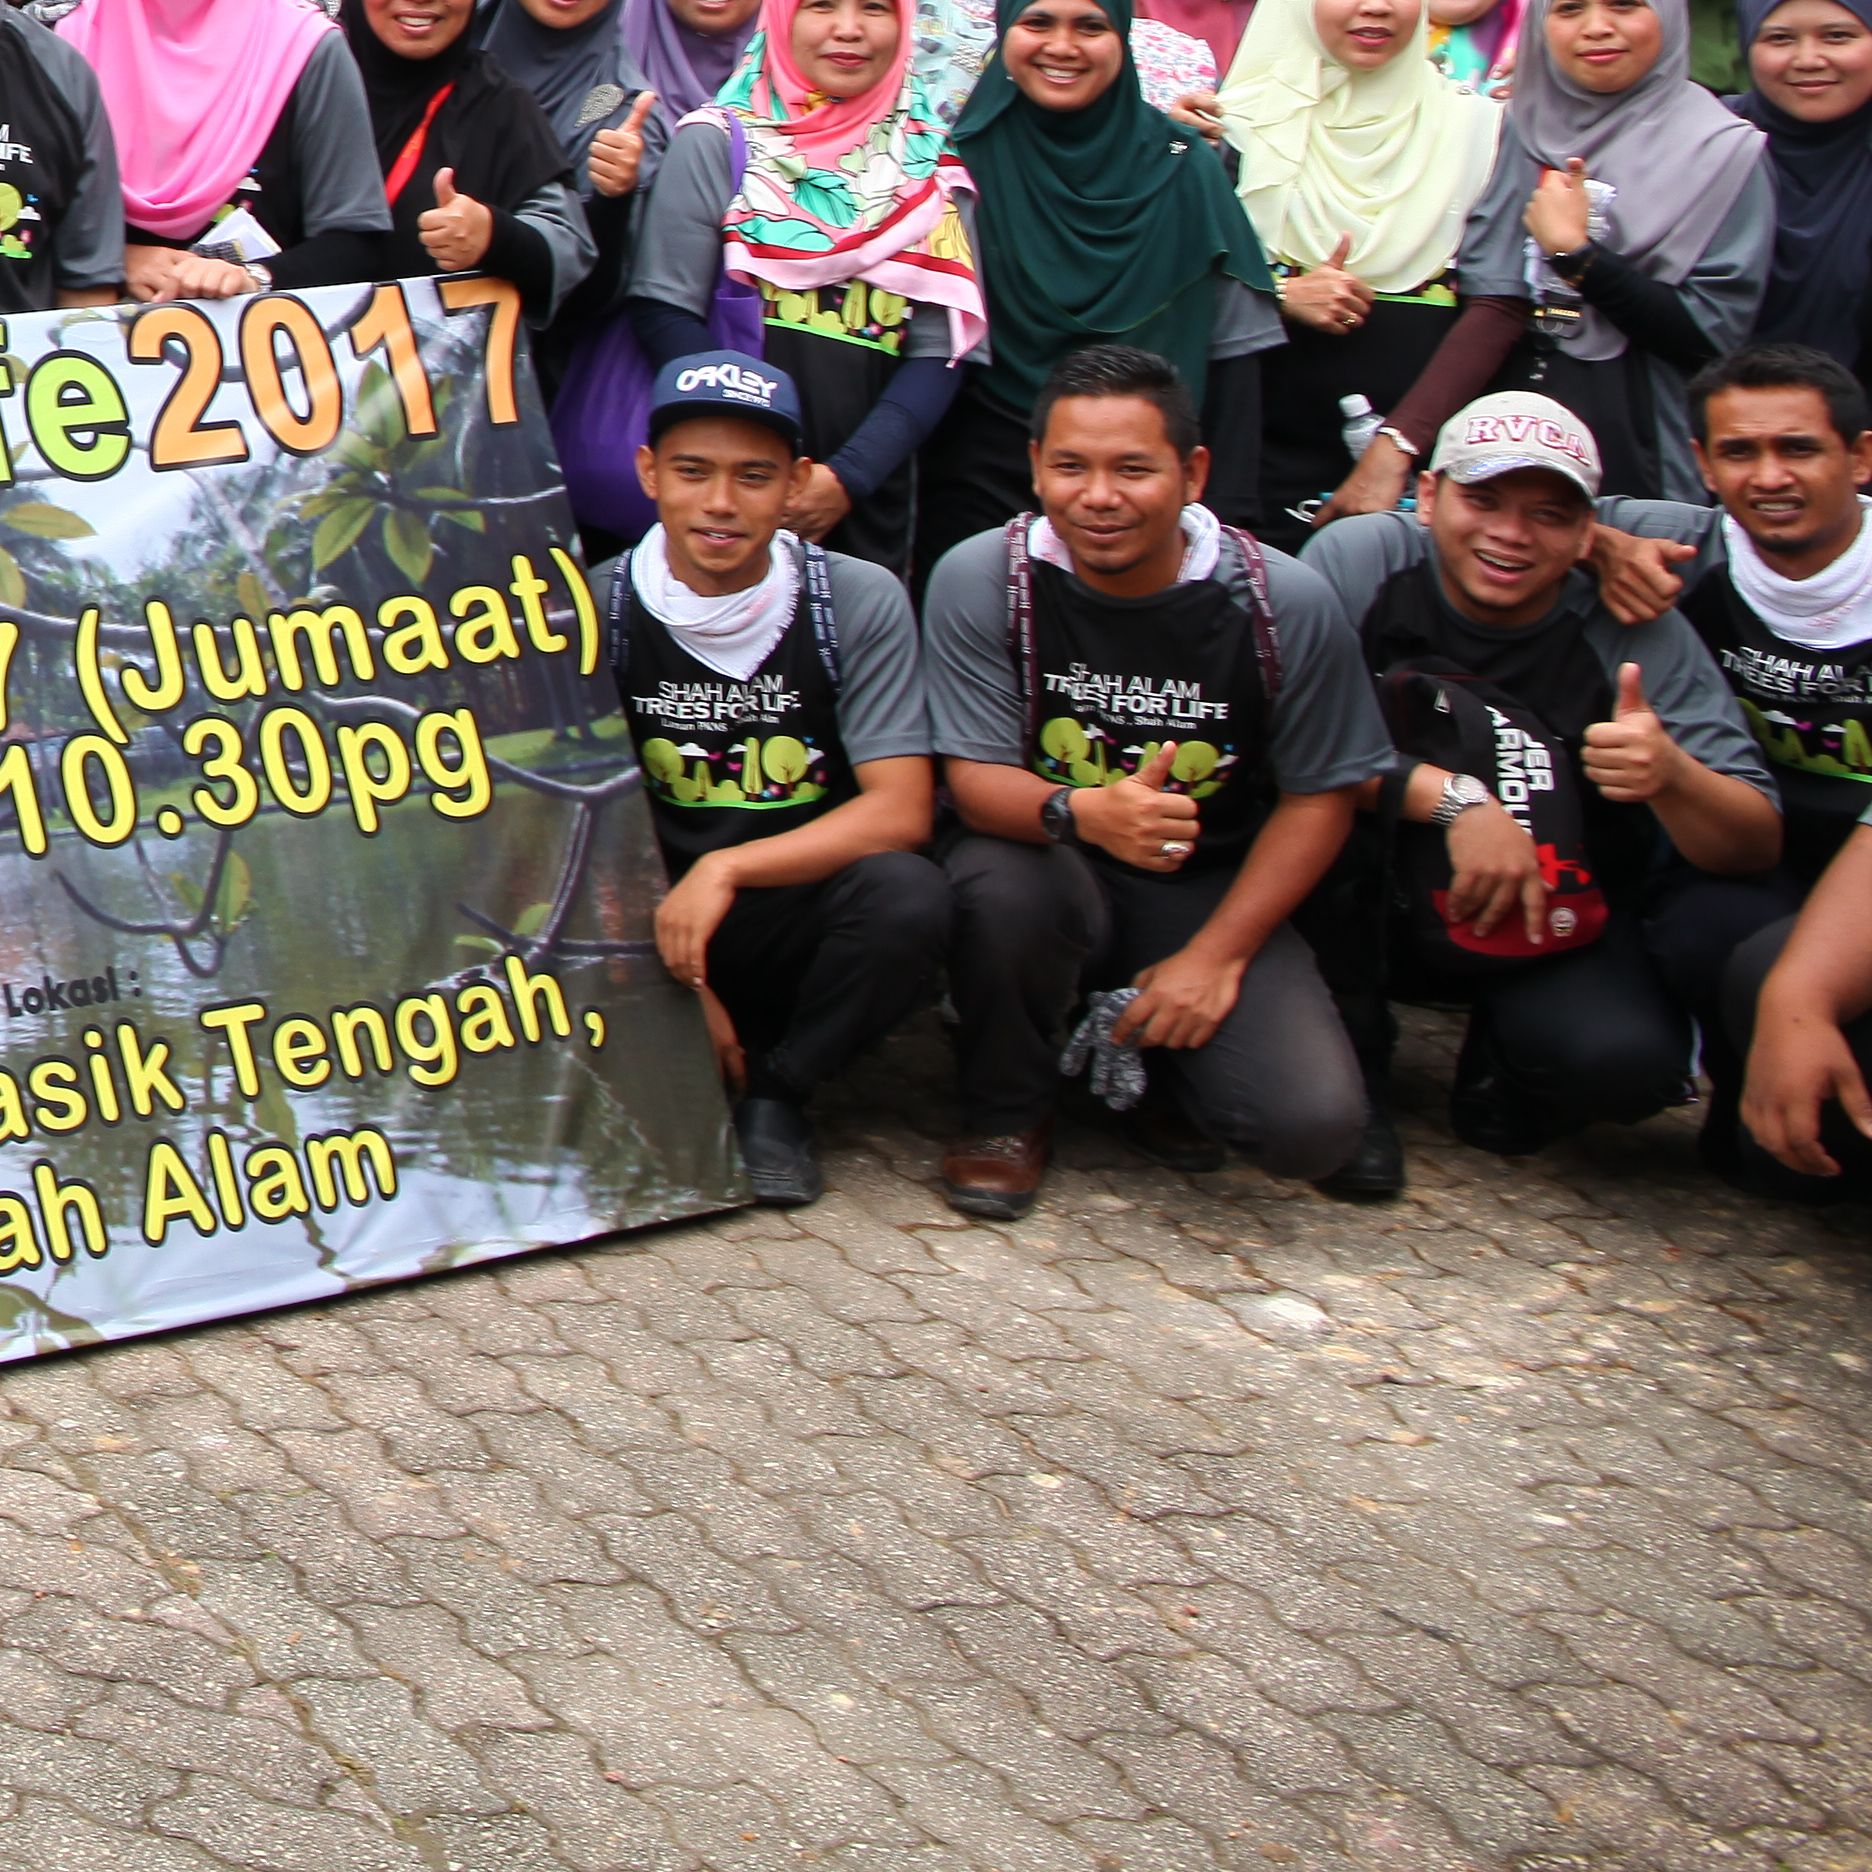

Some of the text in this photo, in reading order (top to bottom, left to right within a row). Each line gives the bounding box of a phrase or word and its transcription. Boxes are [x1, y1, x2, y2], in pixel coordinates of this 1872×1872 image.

[676, 363, 778, 399] OAKLEY
[1465, 414, 1592, 467] RVCA
[75, 546, 599, 745] (Jumaat)
[630, 695, 711, 720] TREES
[713, 694, 760, 720] FOR
[657, 680, 724, 702] SHAH
[1111, 694, 1168, 716] FOR
[1171, 698, 1230, 720] LIFE
[1126, 675, 1201, 701] ALAM
[2, 964, 120, 1018] Lokasi
[201, 951, 606, 1104] Tengah,
[142, 1123, 399, 1248] Alam
